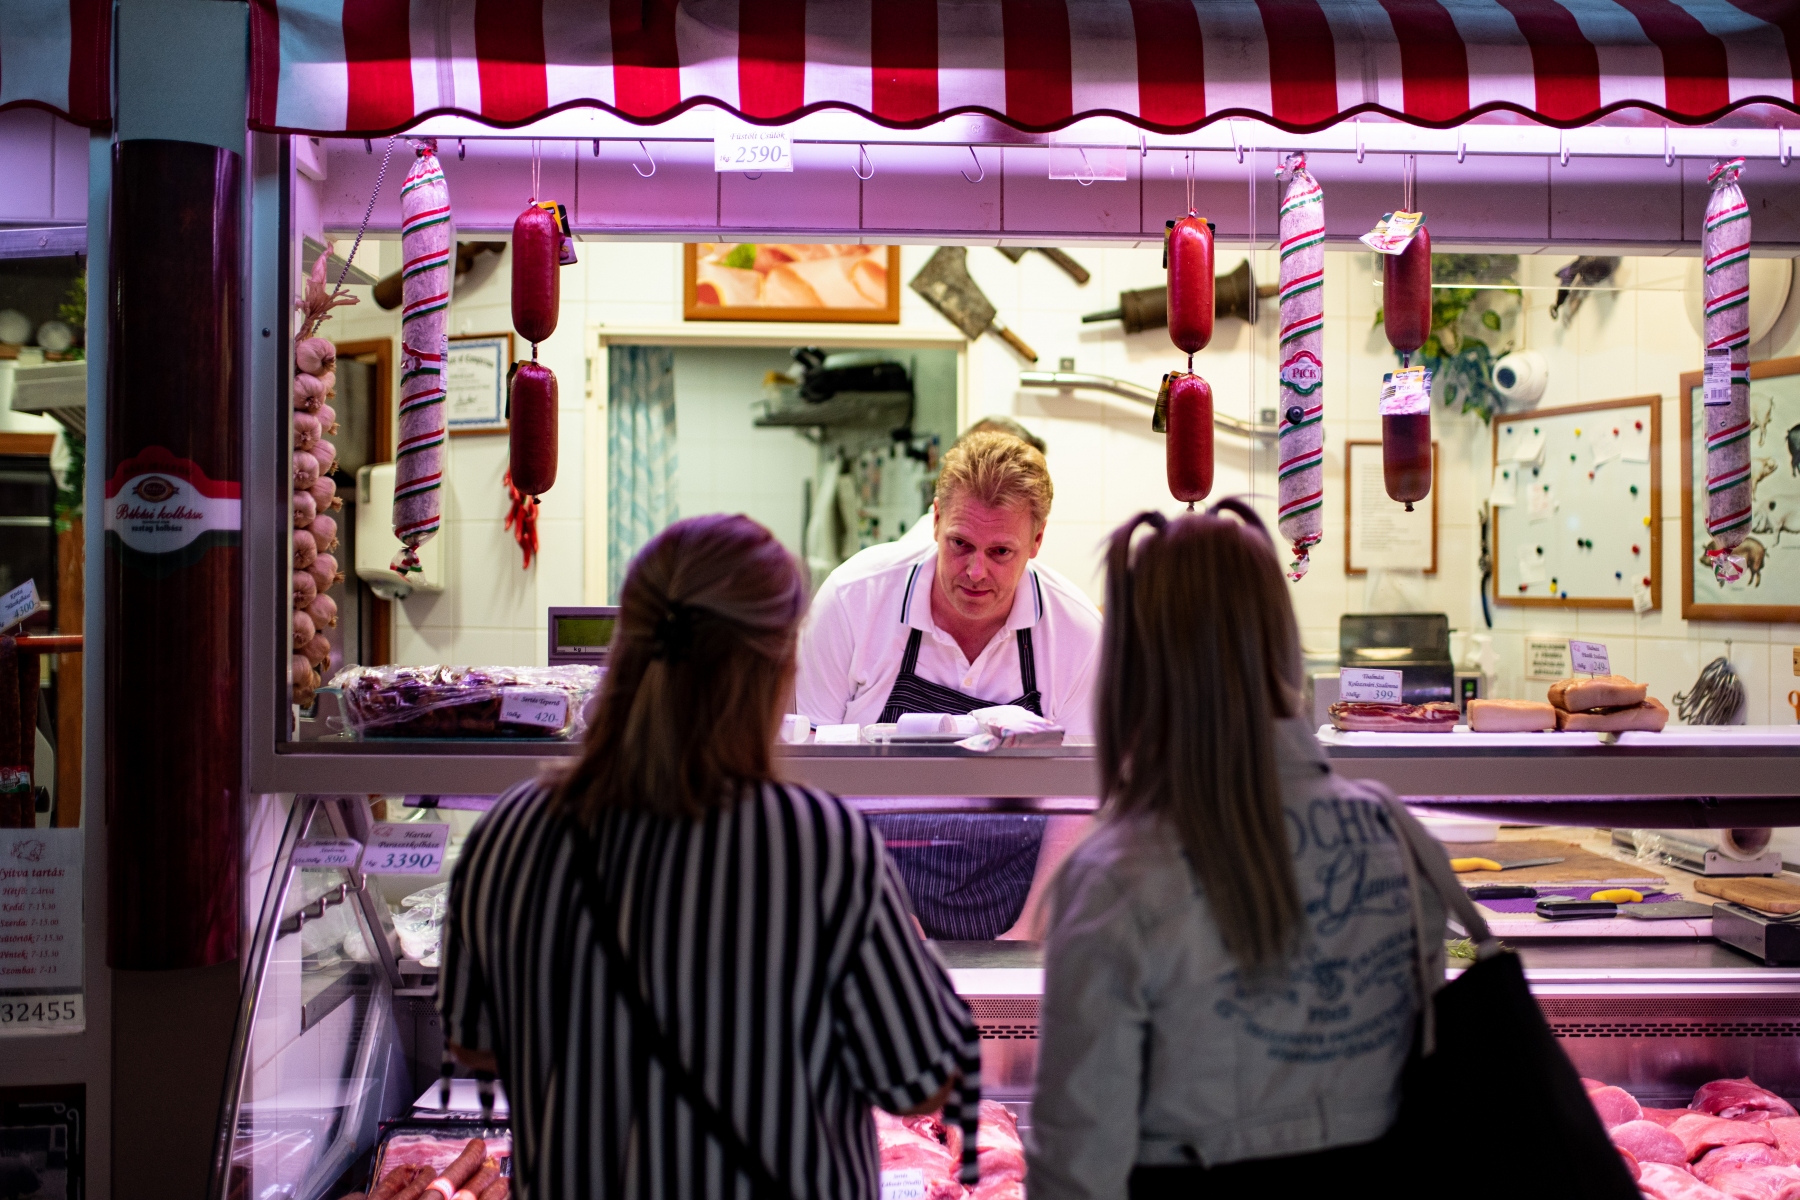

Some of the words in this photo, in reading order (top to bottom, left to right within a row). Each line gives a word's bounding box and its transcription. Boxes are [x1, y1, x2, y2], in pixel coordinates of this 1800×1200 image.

[735, 145, 789, 163] 2590-
[1292, 368, 1316, 378] PICK
[157, 505, 204, 520] kolbász
[131, 525, 154, 533] vastag
[155, 524, 183, 532] kolbász
[1373, 690, 1397, 700] 399-
[534, 711, 559, 723] 420-
[404, 830, 433, 839] Hartai
[378, 841, 440, 850] Parasztkolbász
[324, 854, 348, 864] 890-
[381, 852, 440, 868] 3390-
[0, 867, 29, 881] yitva
[32, 866, 65, 878] tartás:
[2, 902, 25, 912] Kedd:
[0, 918, 28, 927] Szerda:
[0, 965, 37, 975] Szombat:
[39, 965, 57, 974] 7-13
[1, 1000, 76, 1022] 32455
